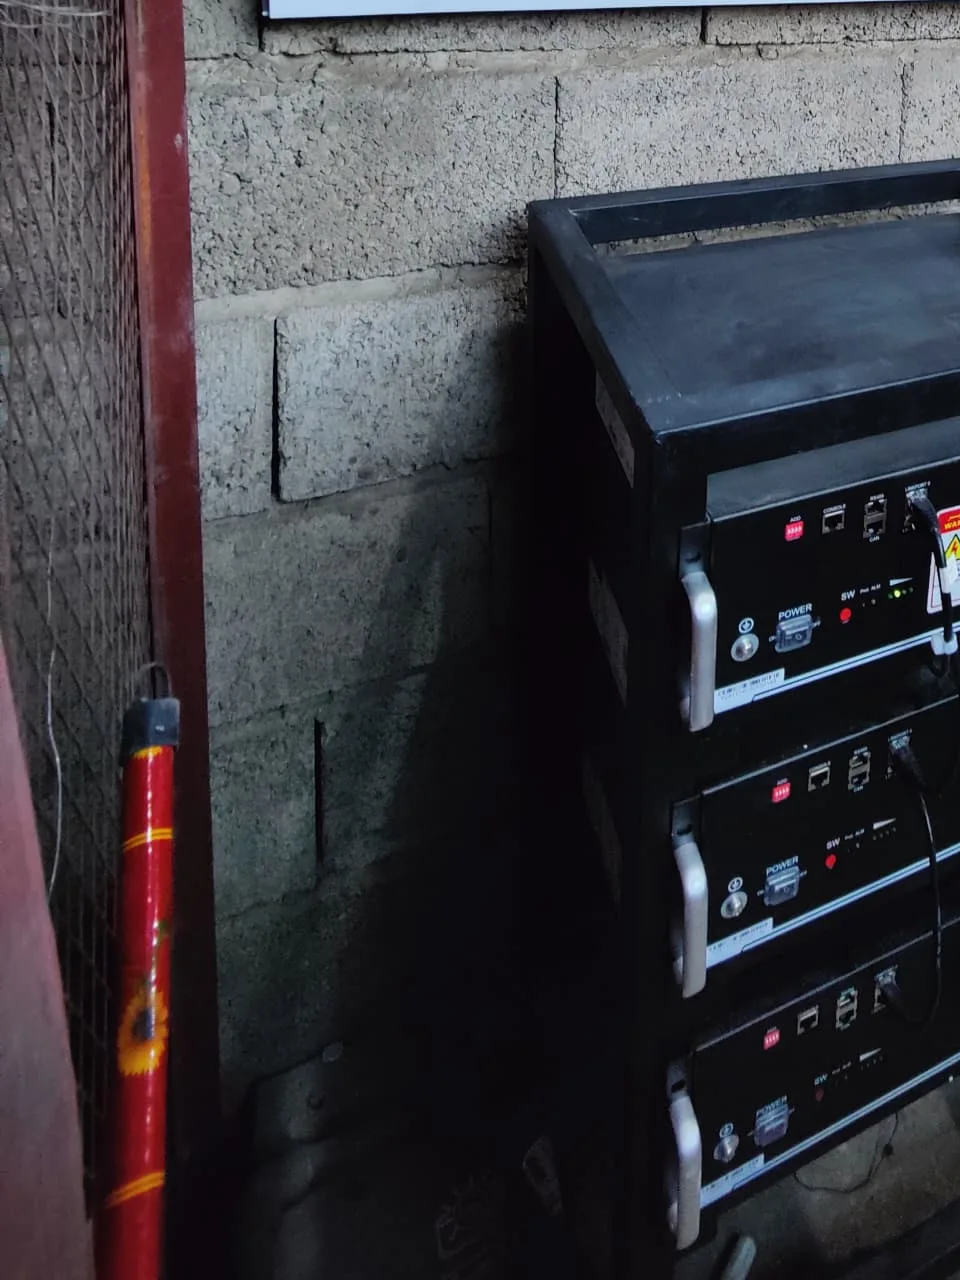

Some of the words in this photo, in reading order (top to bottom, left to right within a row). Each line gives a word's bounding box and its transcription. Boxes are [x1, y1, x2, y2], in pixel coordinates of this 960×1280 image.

[840, 589, 856, 602] SW
[778, 602, 813, 621] POWER
[826, 837, 840, 850] SW
[766, 855, 799, 875] POWER
